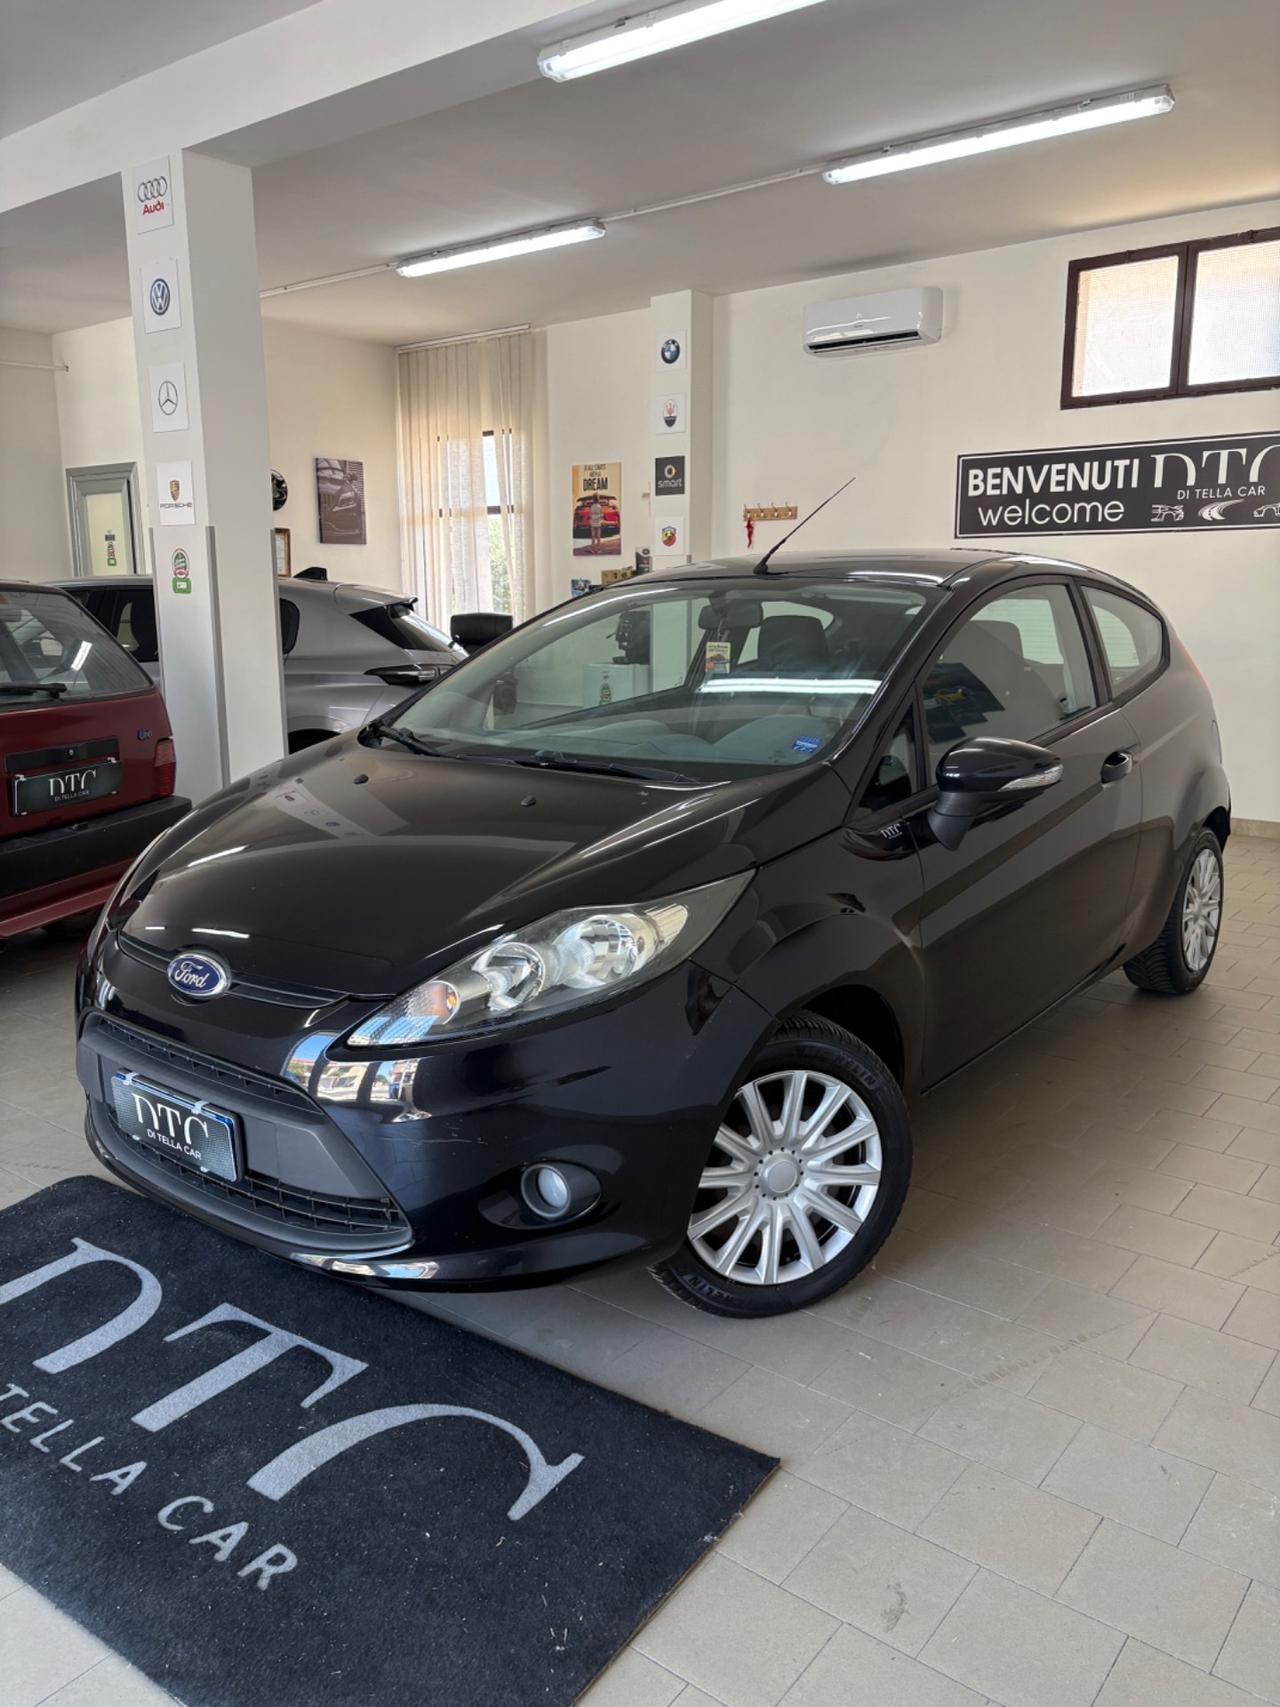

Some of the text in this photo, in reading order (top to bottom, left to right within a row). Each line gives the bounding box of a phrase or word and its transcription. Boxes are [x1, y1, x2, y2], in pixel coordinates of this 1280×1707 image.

[143, 200, 165, 216] Audi
[583, 477, 608, 491] DREAM
[658, 478, 682, 489] smart
[968, 458, 1140, 497] BENVENUTI
[1177, 485, 1266, 500] DI TELLA CAR
[978, 498, 1125, 527] welcome
[48, 769, 97, 796] DTC
[174, 960, 210, 988] Ford
[131, 1092, 209, 1145] DTC
[146, 1128, 202, 1161] DI TELLA CAR
[157, 1495, 299, 1590] CAR
